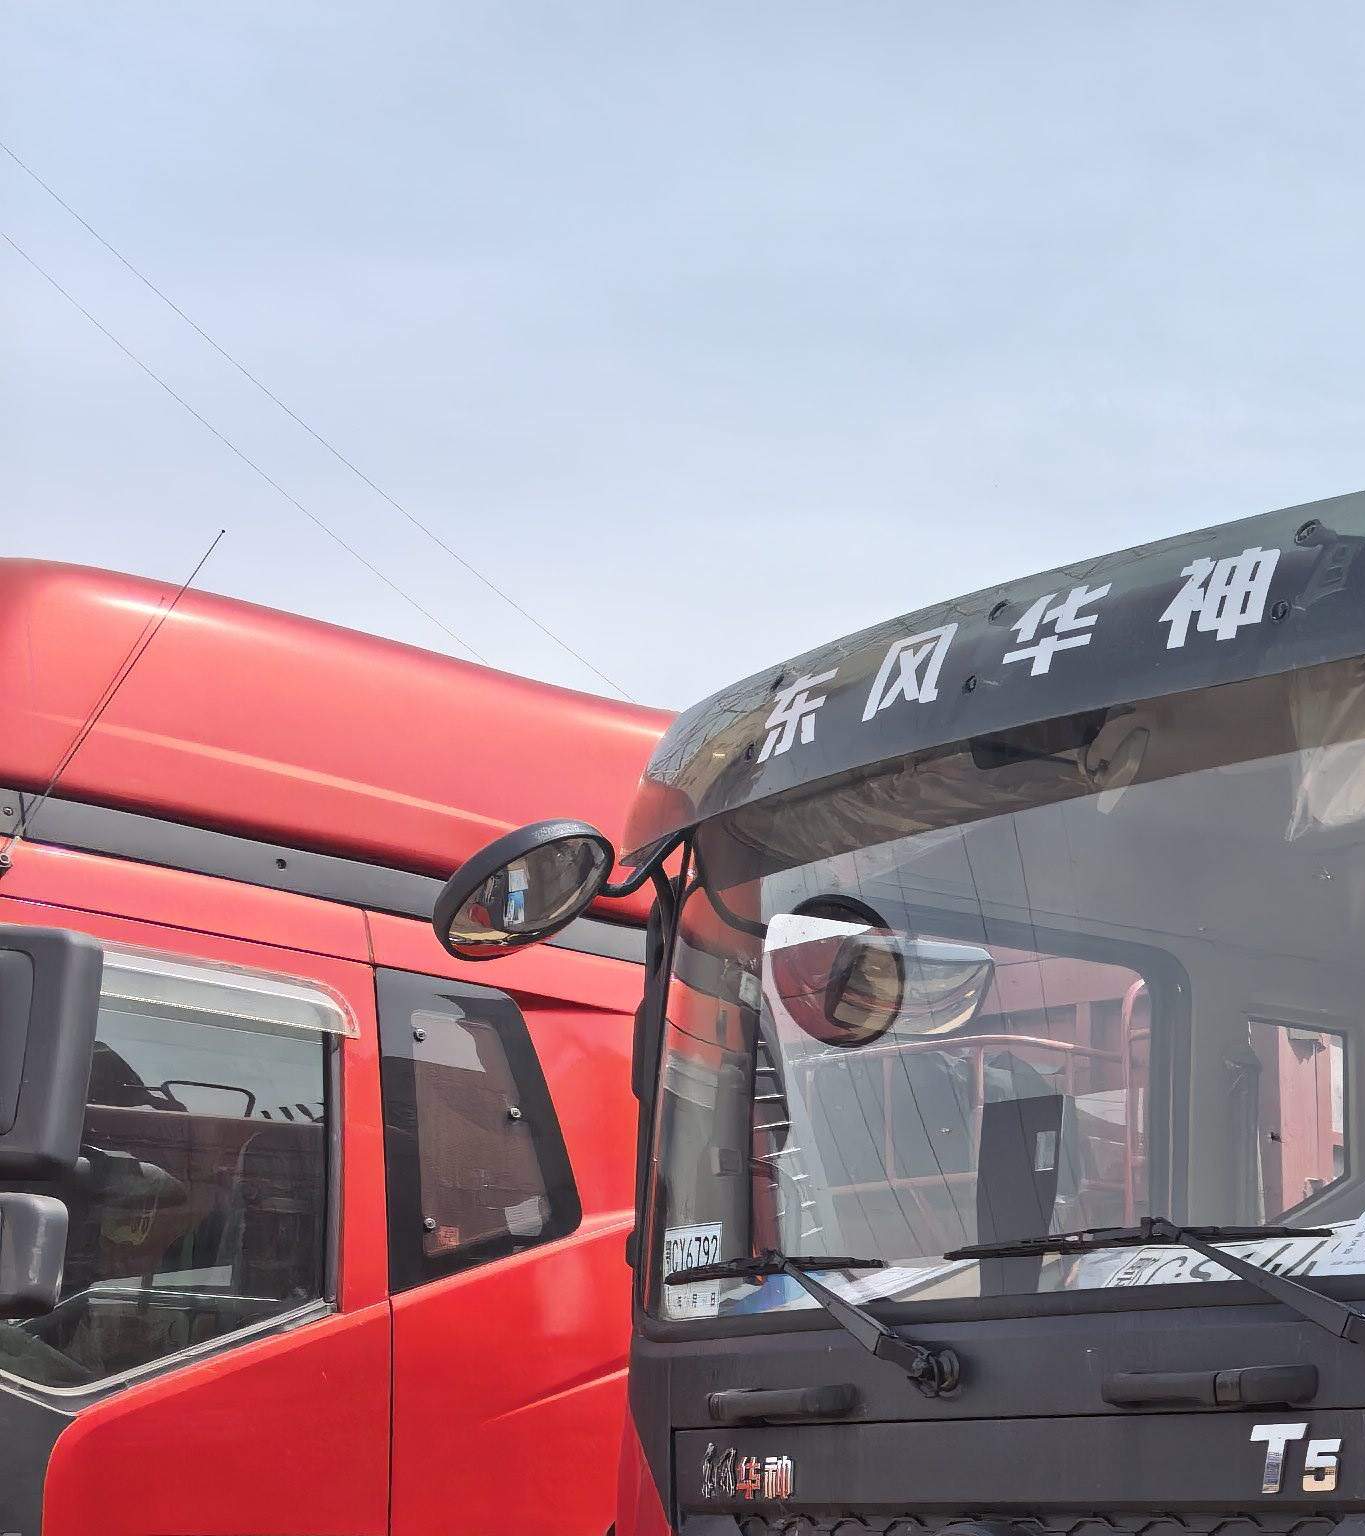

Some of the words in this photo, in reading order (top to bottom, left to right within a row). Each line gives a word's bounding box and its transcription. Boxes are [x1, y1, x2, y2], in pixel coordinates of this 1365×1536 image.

[756, 546, 1281, 765] 东风华神
[1249, 1422, 1342, 1494] T5
